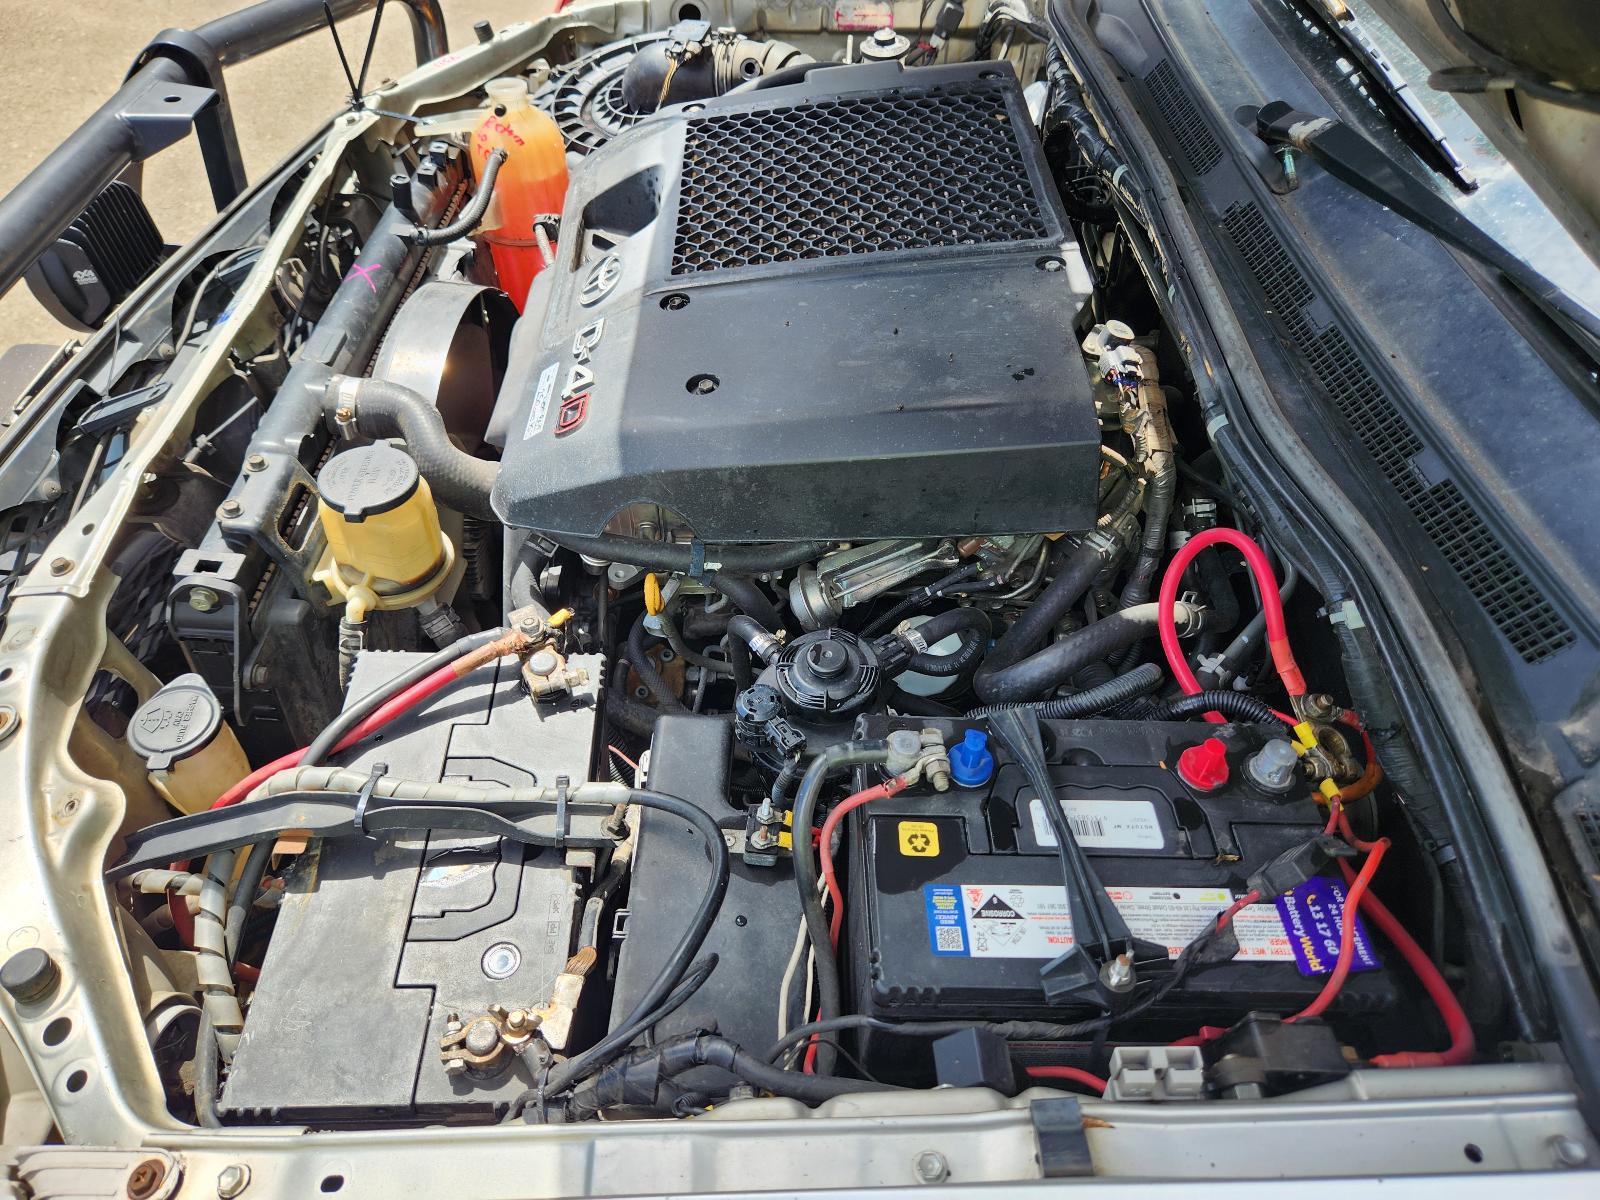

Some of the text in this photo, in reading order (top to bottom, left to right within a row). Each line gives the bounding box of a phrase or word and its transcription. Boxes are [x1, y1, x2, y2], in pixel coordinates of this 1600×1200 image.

[554, 317, 604, 438] D-4D
[1331, 885, 1345, 903] FOR
[981, 909, 1016, 918] CORROSIVE
[1328, 903, 1339, 916] 24
[1316, 921, 1332, 938] 17
[1323, 939, 1340, 956] 60
